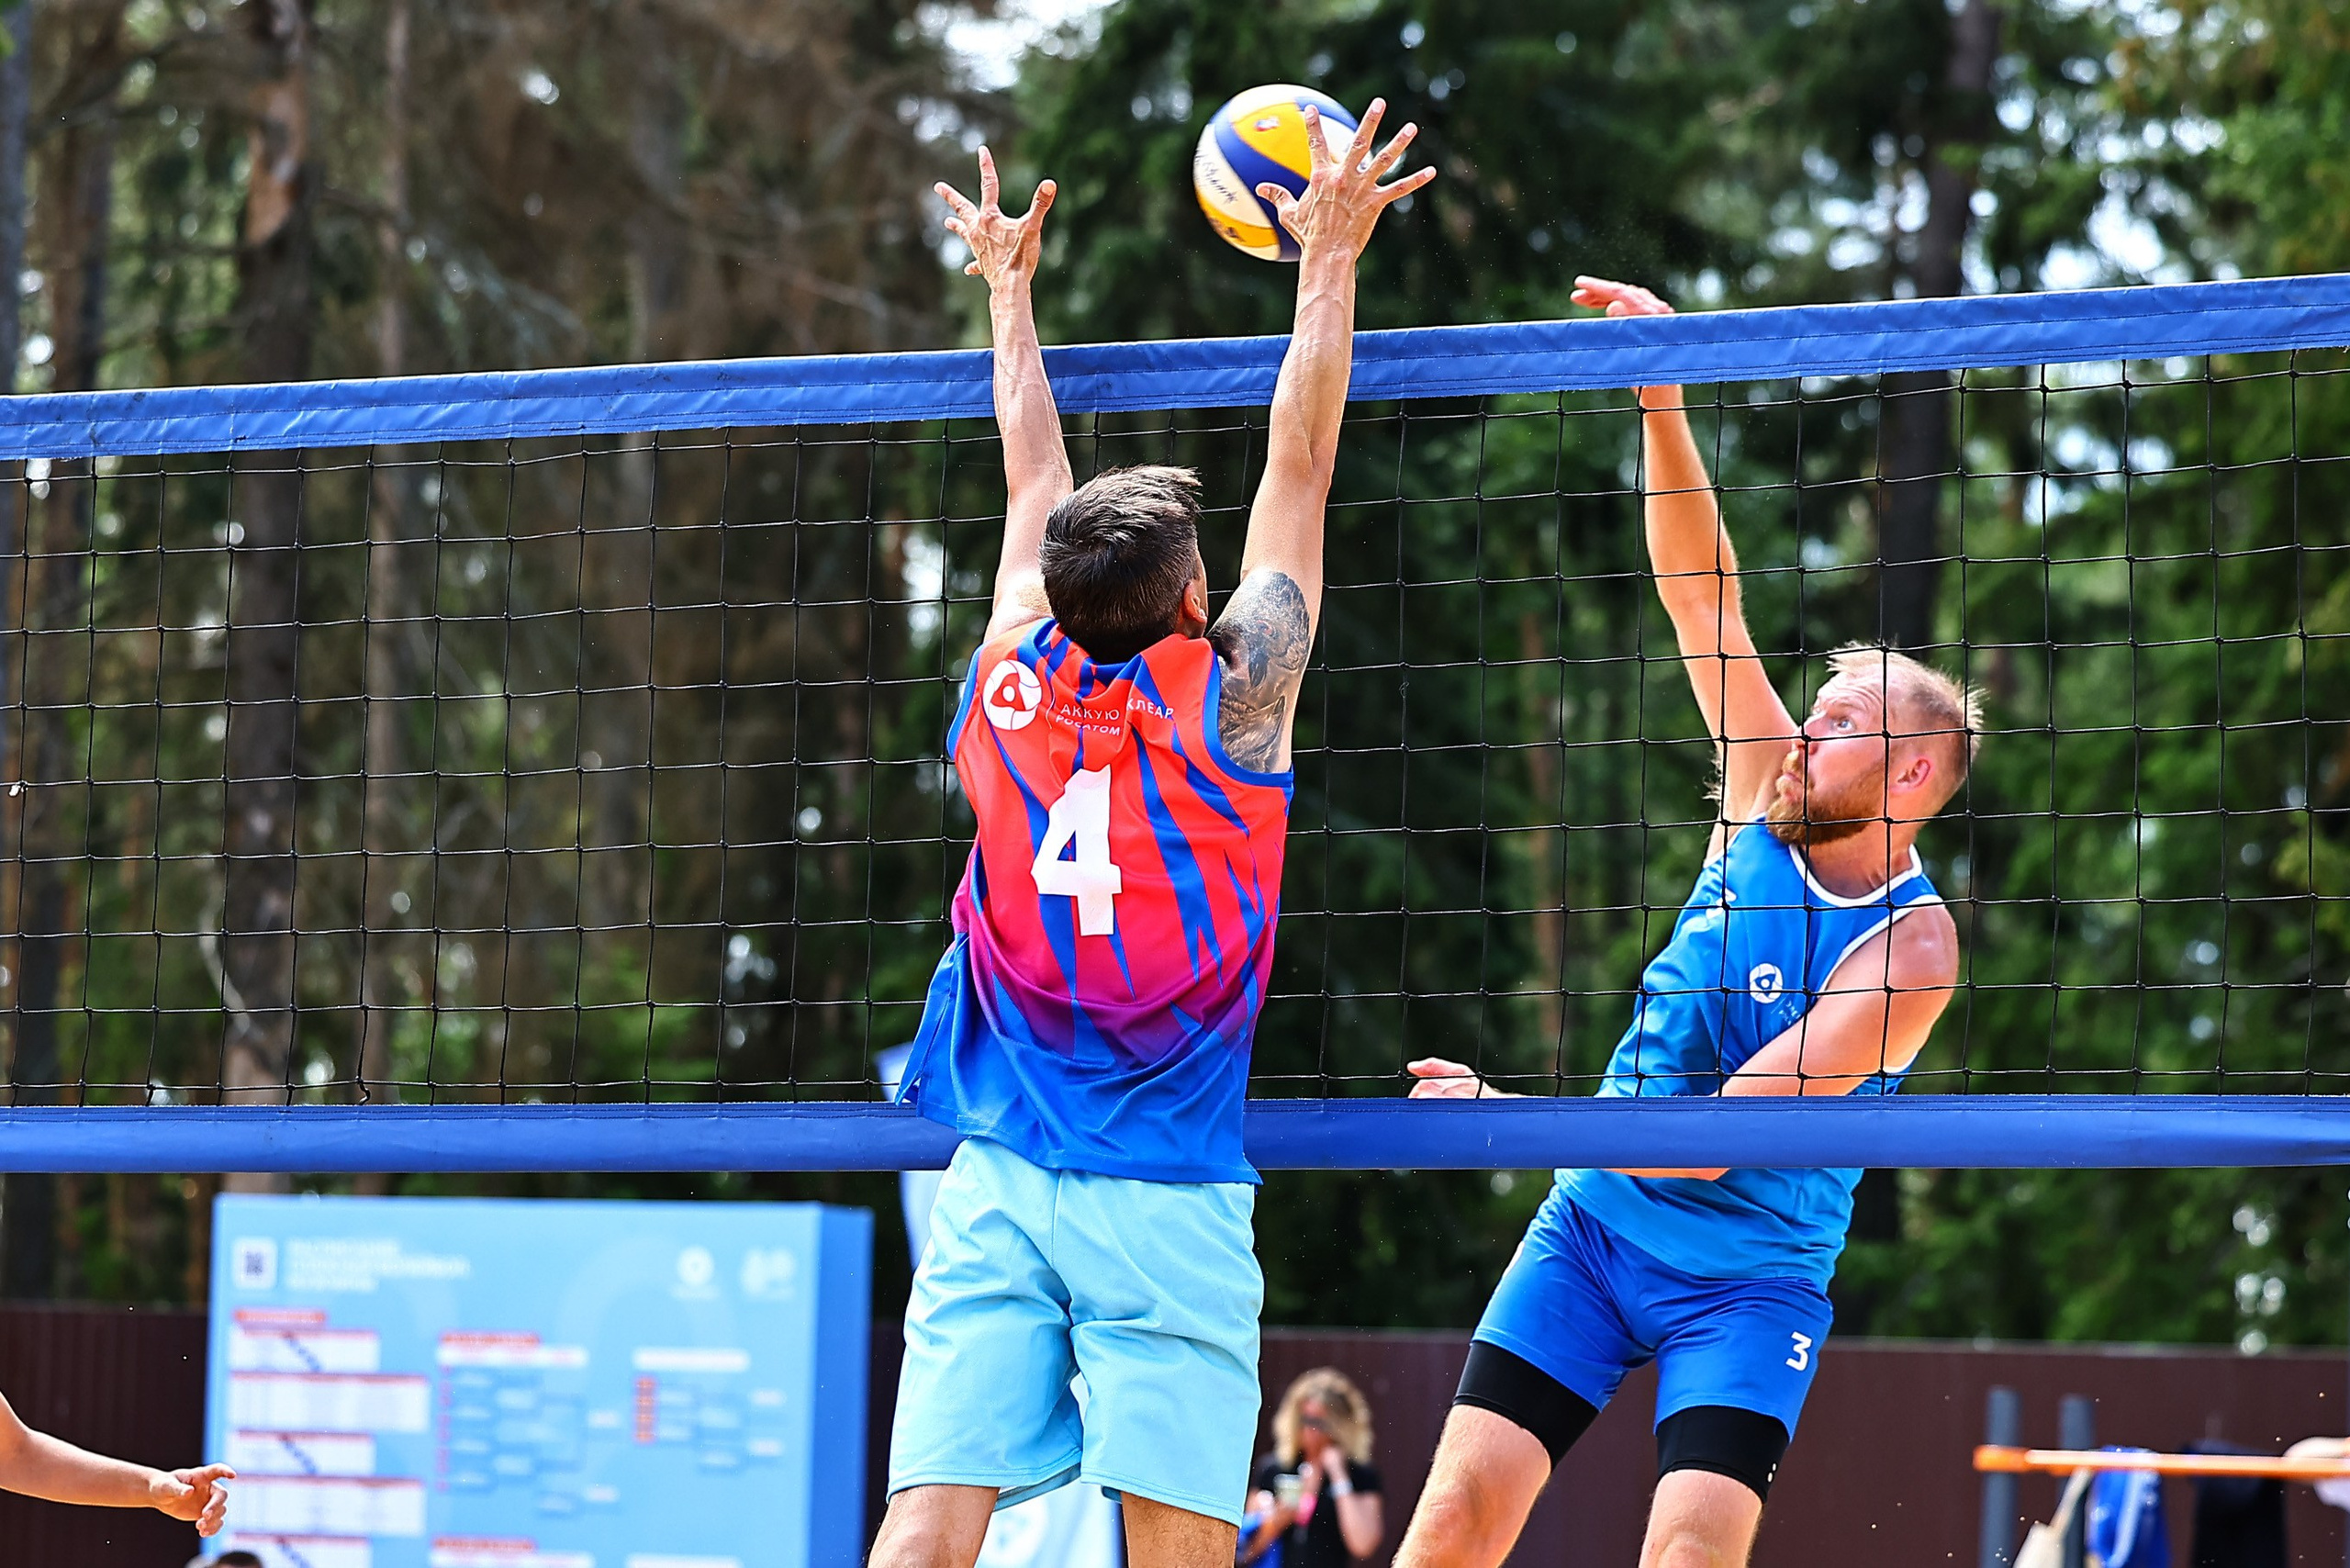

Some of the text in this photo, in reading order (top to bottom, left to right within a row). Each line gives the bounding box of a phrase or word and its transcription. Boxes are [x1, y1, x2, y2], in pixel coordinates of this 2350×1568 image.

[1056, 714, 1121, 736] РОСАТОМ
[1060, 703, 1120, 721] АККУЮ
[1030, 764, 1122, 936] 4
[1785, 1331, 1812, 1371] 3
